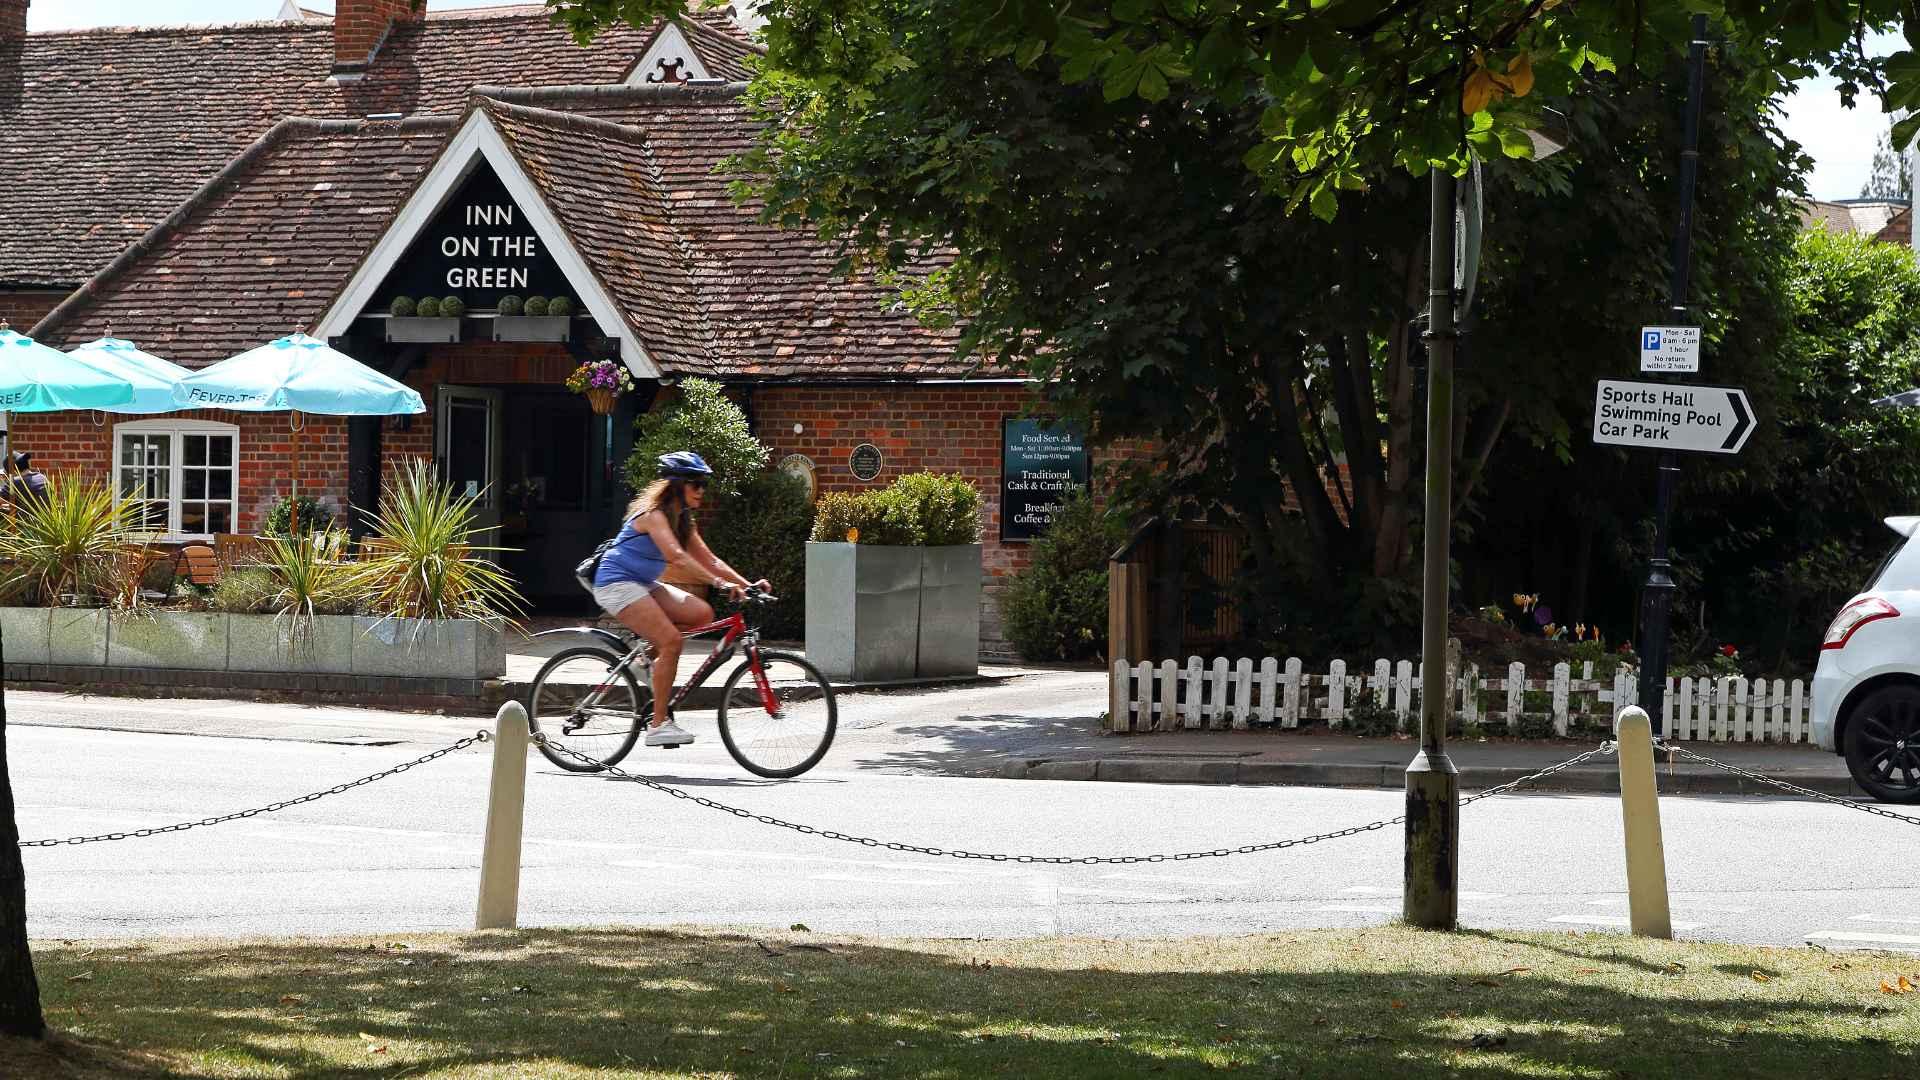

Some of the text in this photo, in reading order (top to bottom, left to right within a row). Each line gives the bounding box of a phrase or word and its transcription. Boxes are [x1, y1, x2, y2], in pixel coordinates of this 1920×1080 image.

[466, 204, 513, 226] INN
[441, 236, 536, 257] ON THE
[446, 267, 528, 289] GREEN
[1647, 333, 1659, 349] P
[1602, 386, 1694, 407] Sports Hall
[1600, 404, 1722, 427] Swimming Pool
[1022, 433, 1042, 443] Food
[1599, 421, 1670, 441] Car Park
[1021, 469, 1071, 480] Traditional
[1007, 480, 1082, 491] Cask & Craft Ale
[1014, 514, 1042, 524] Coffee
[1043, 515, 1051, 524] &
